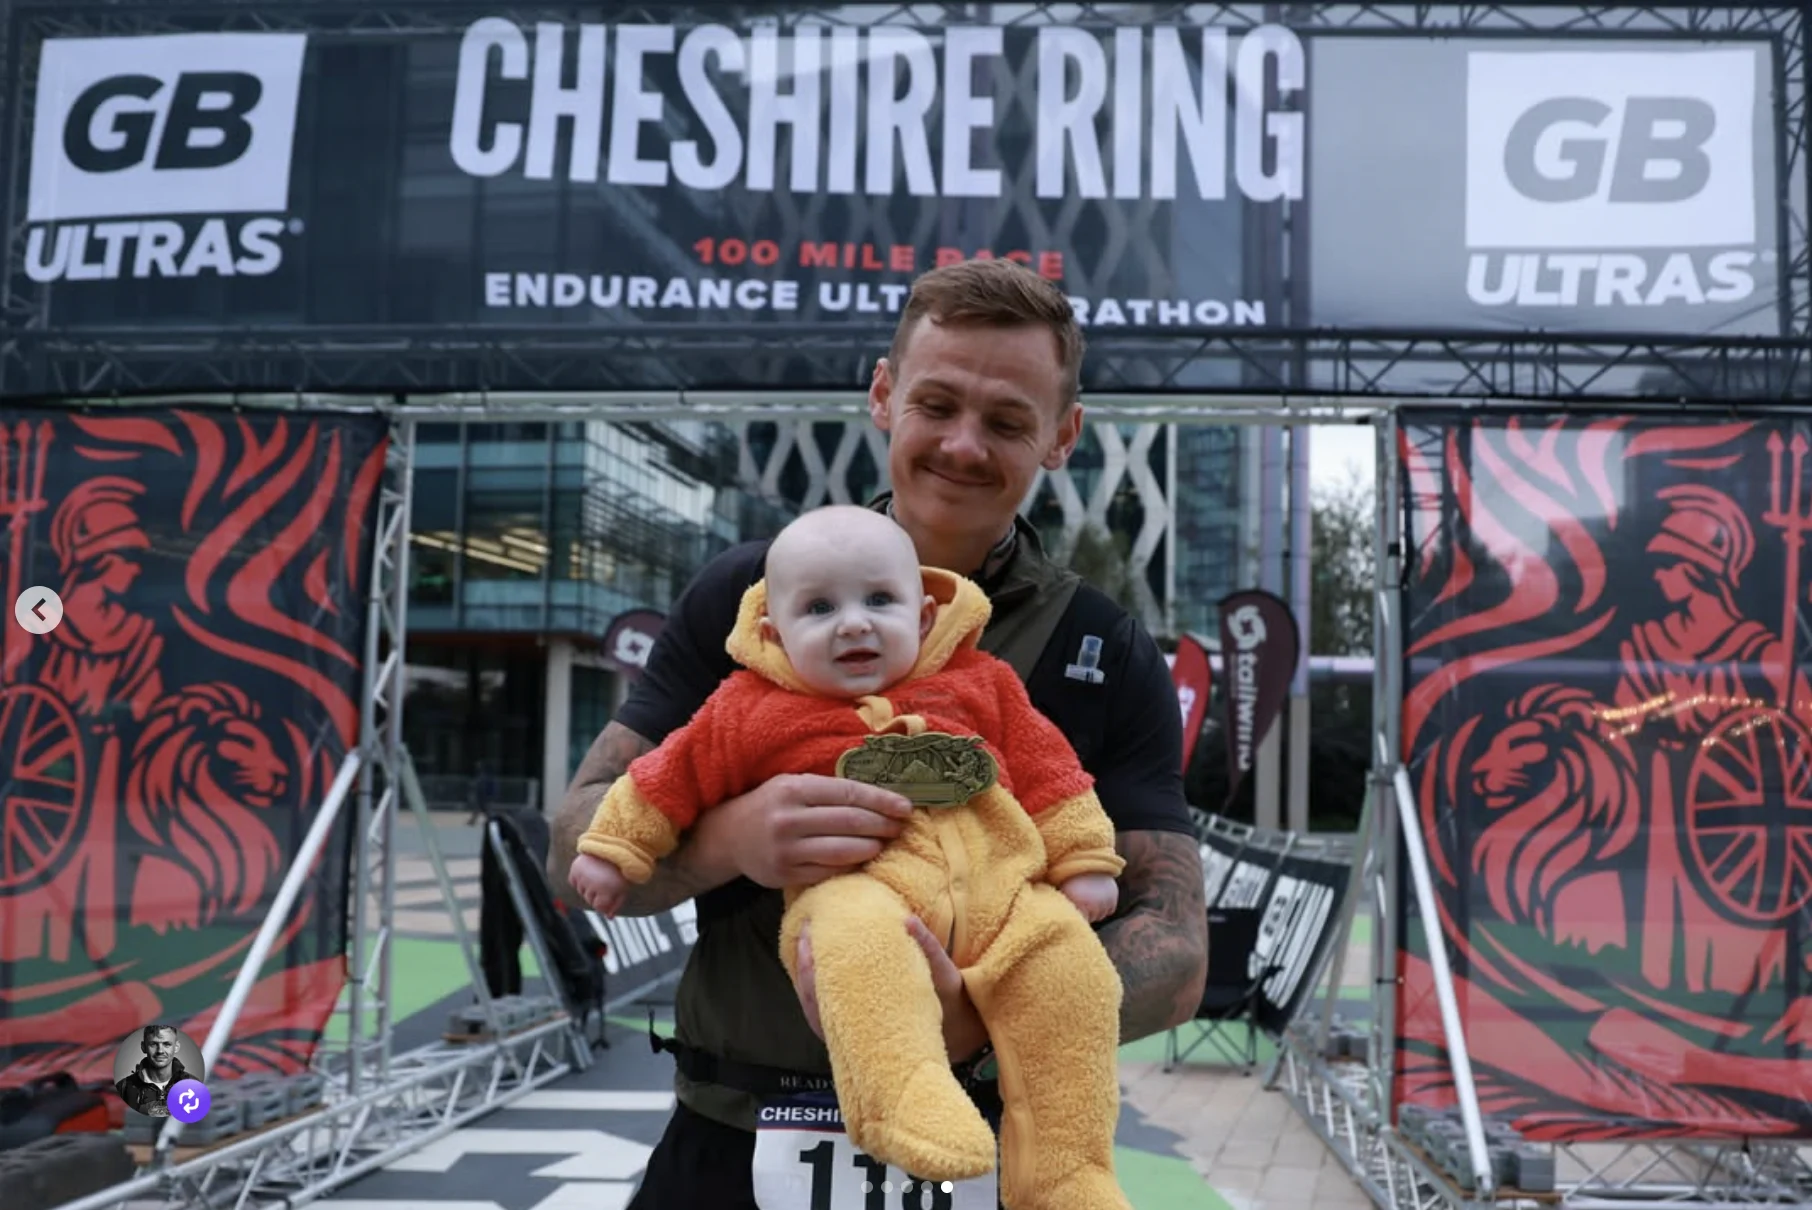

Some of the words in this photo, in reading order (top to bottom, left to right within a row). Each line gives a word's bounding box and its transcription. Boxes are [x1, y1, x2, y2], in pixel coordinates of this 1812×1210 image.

[62, 71, 264, 174] GB
[449, 17, 1003, 197] CHESHIRE
[1036, 24, 1305, 203] RING
[1503, 96, 1717, 204] GB
[24, 218, 285, 282] ULTRAS
[694, 238, 780, 266] 100
[800, 242, 915, 271] MILE
[1466, 250, 1756, 306] ULTRAS
[485, 273, 799, 310] ENDURANCE
[818, 282, 1266, 326] ULTRATHON
[780, 1075, 836, 1090] READ
[760, 1106, 846, 1123] CHESHI
